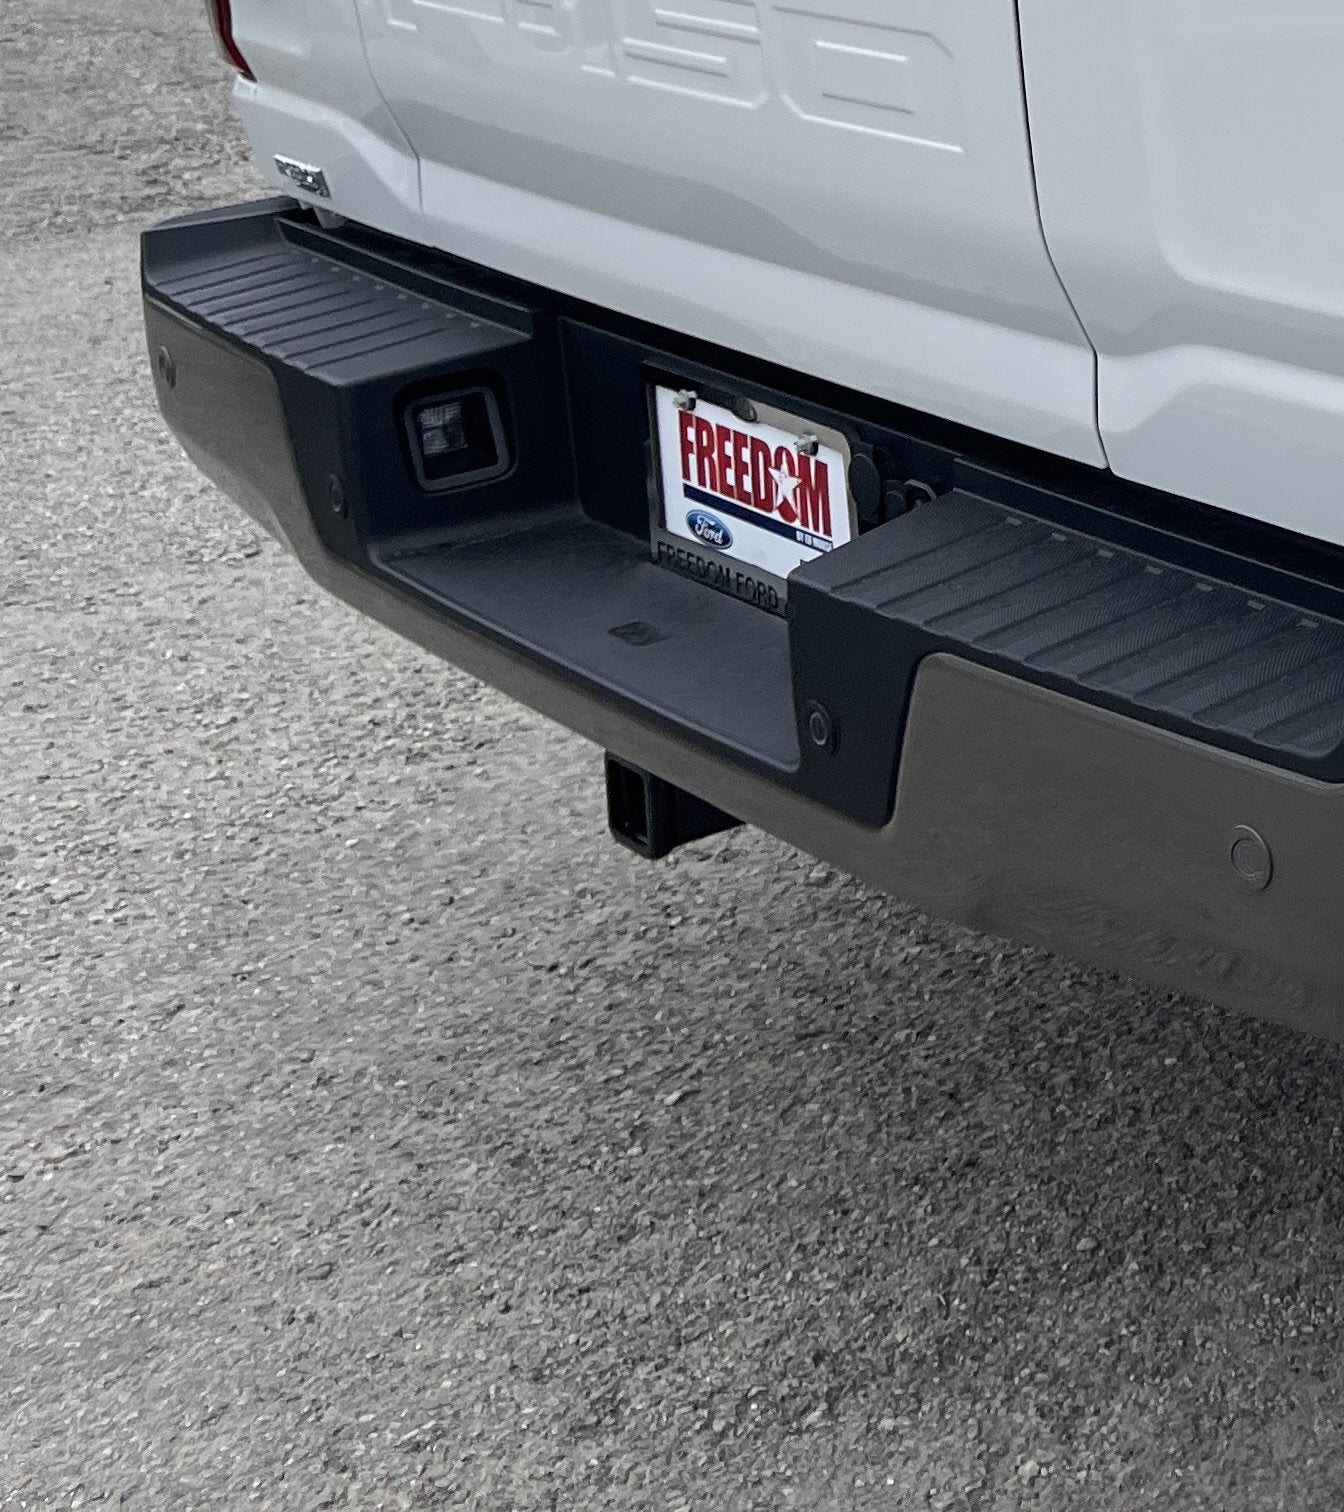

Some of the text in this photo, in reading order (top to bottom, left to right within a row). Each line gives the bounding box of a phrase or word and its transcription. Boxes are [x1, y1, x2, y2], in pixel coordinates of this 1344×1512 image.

[678, 410, 833, 537] FREEDOM
[694, 515, 725, 544] Ford
[657, 540, 779, 610] FREEDOM FORD
